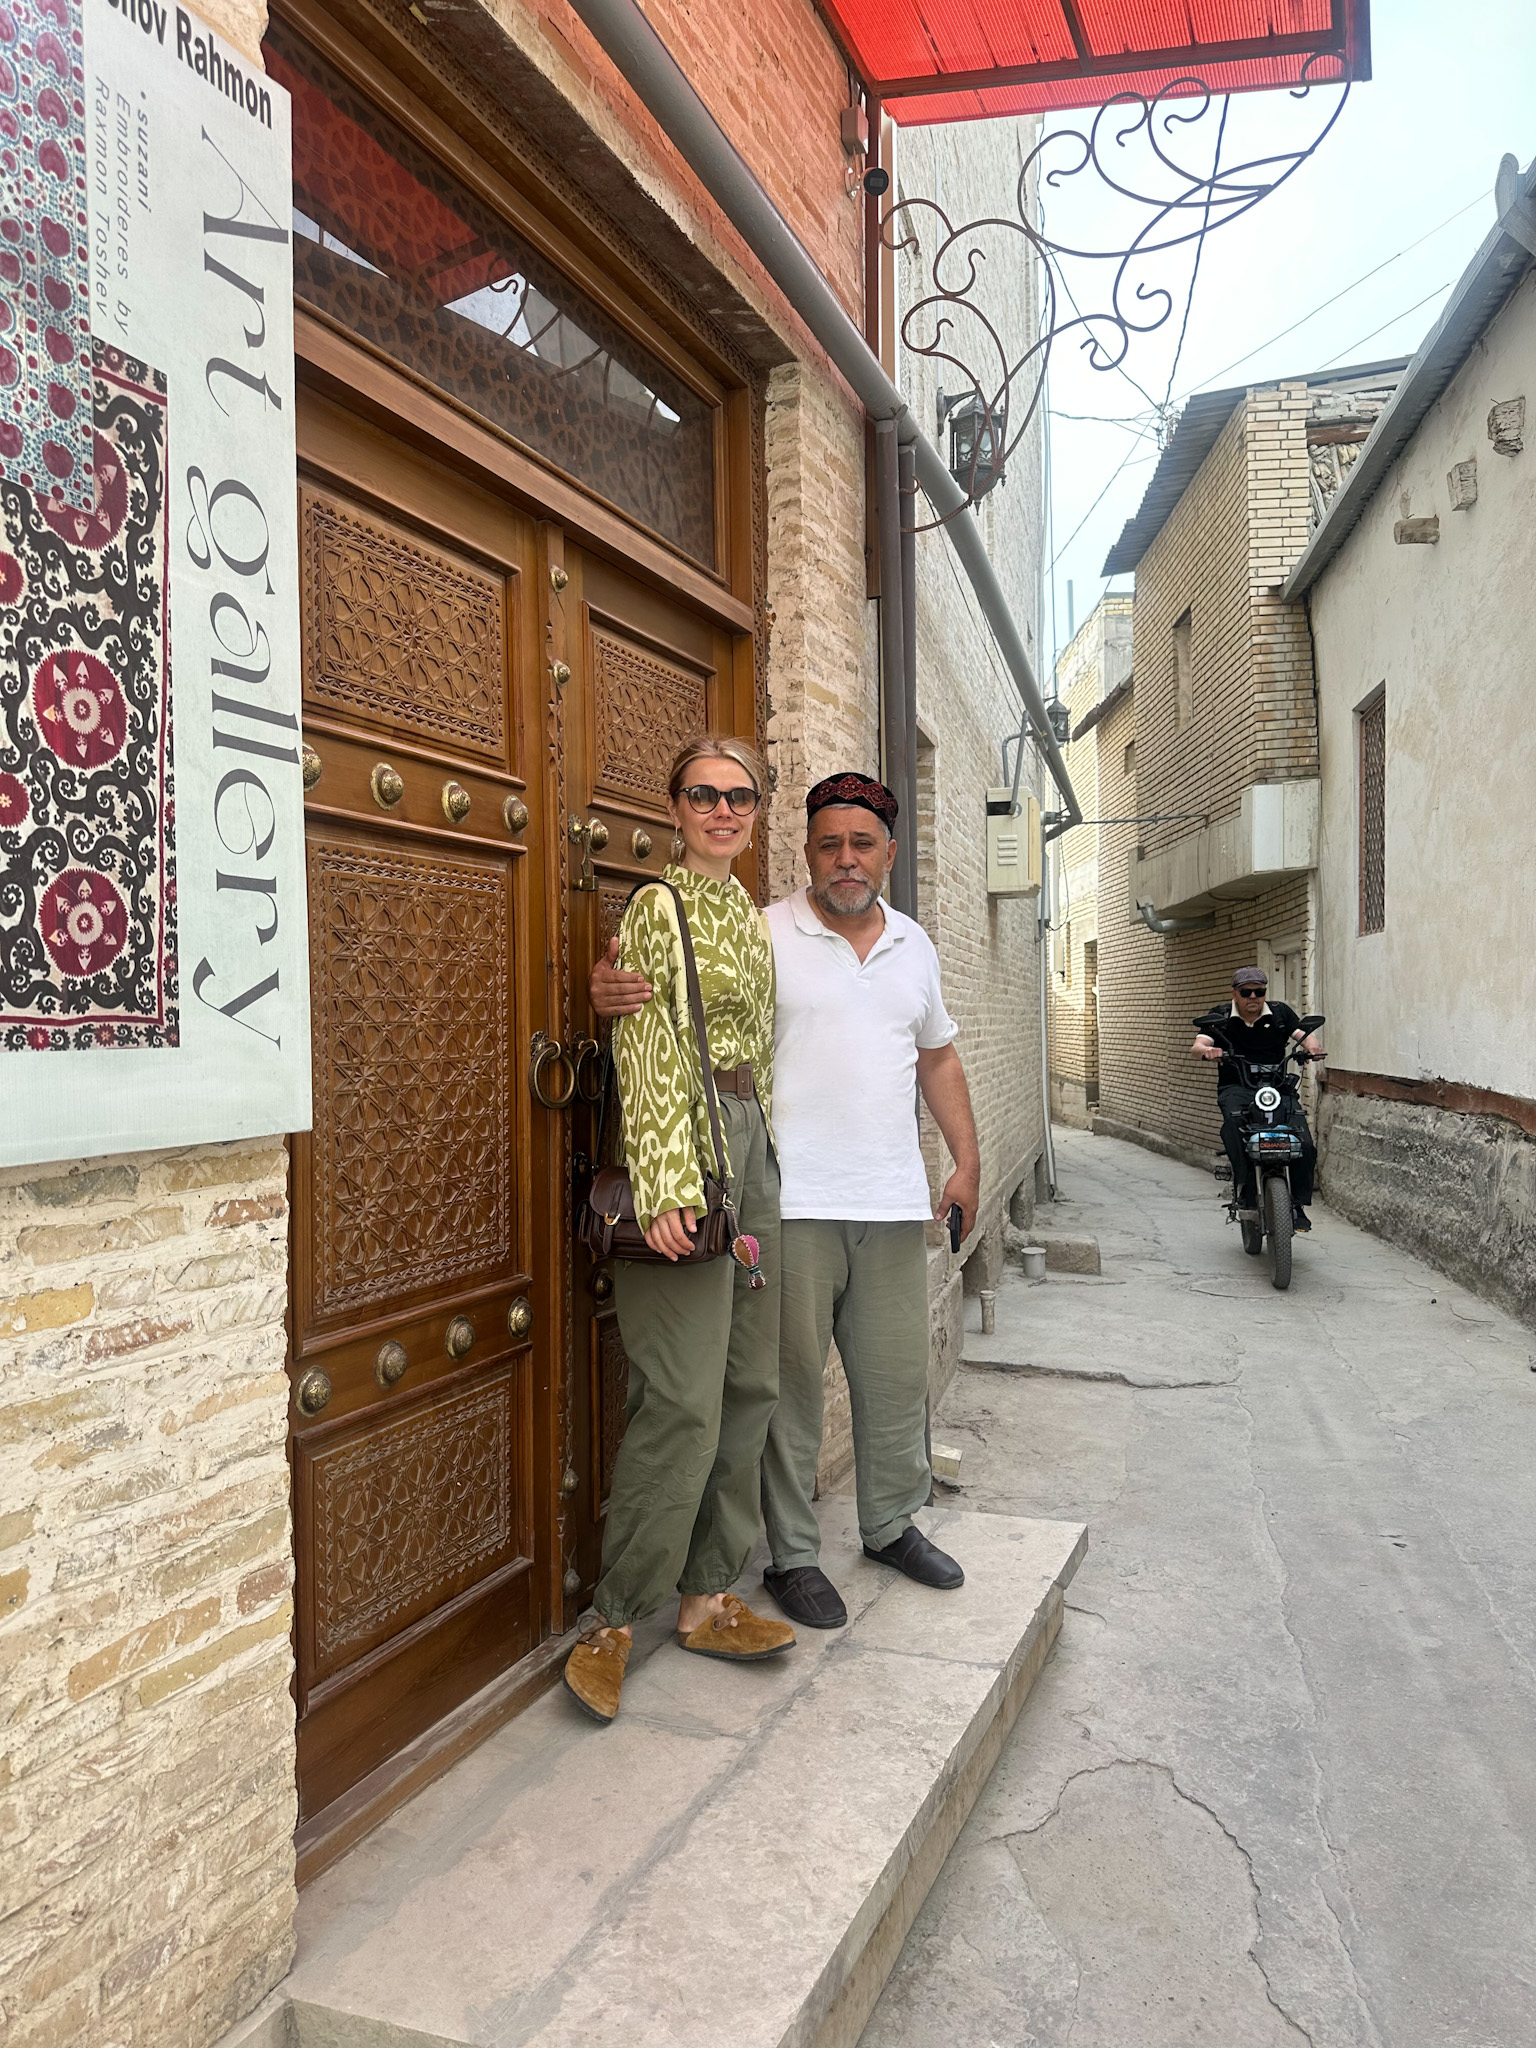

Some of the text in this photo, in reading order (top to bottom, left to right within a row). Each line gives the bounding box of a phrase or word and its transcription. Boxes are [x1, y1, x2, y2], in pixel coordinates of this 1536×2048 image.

[138, 108, 152, 213] suzani
[176, 6, 272, 130] Rahmon
[96, 76, 111, 317] Raxmon Toshev
[113, 93, 132, 337] Embroideres by
[186, 124, 301, 1051] Art gallery
